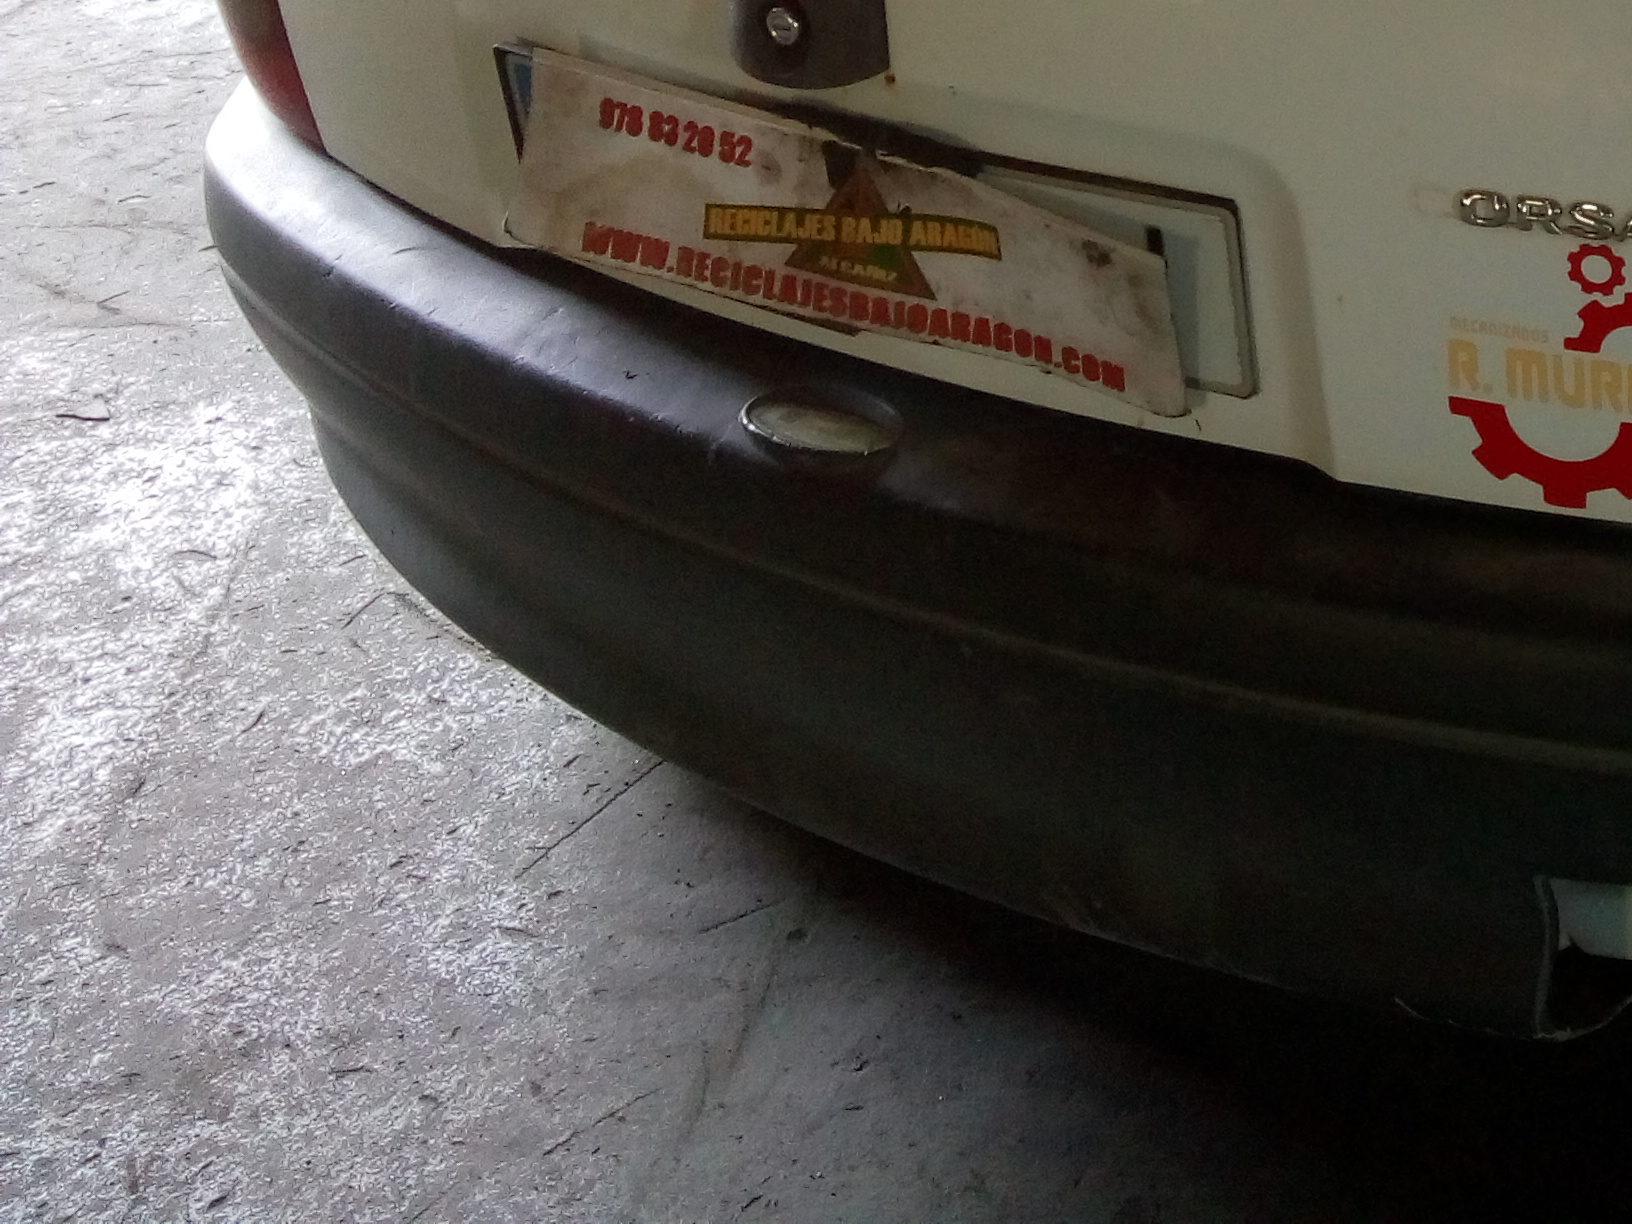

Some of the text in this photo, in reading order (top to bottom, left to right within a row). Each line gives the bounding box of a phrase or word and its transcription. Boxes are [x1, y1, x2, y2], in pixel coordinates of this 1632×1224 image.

[718, 130, 753, 167] 52
[708, 207, 836, 242] RECICLAJES
[840, 216, 904, 245] BAJO
